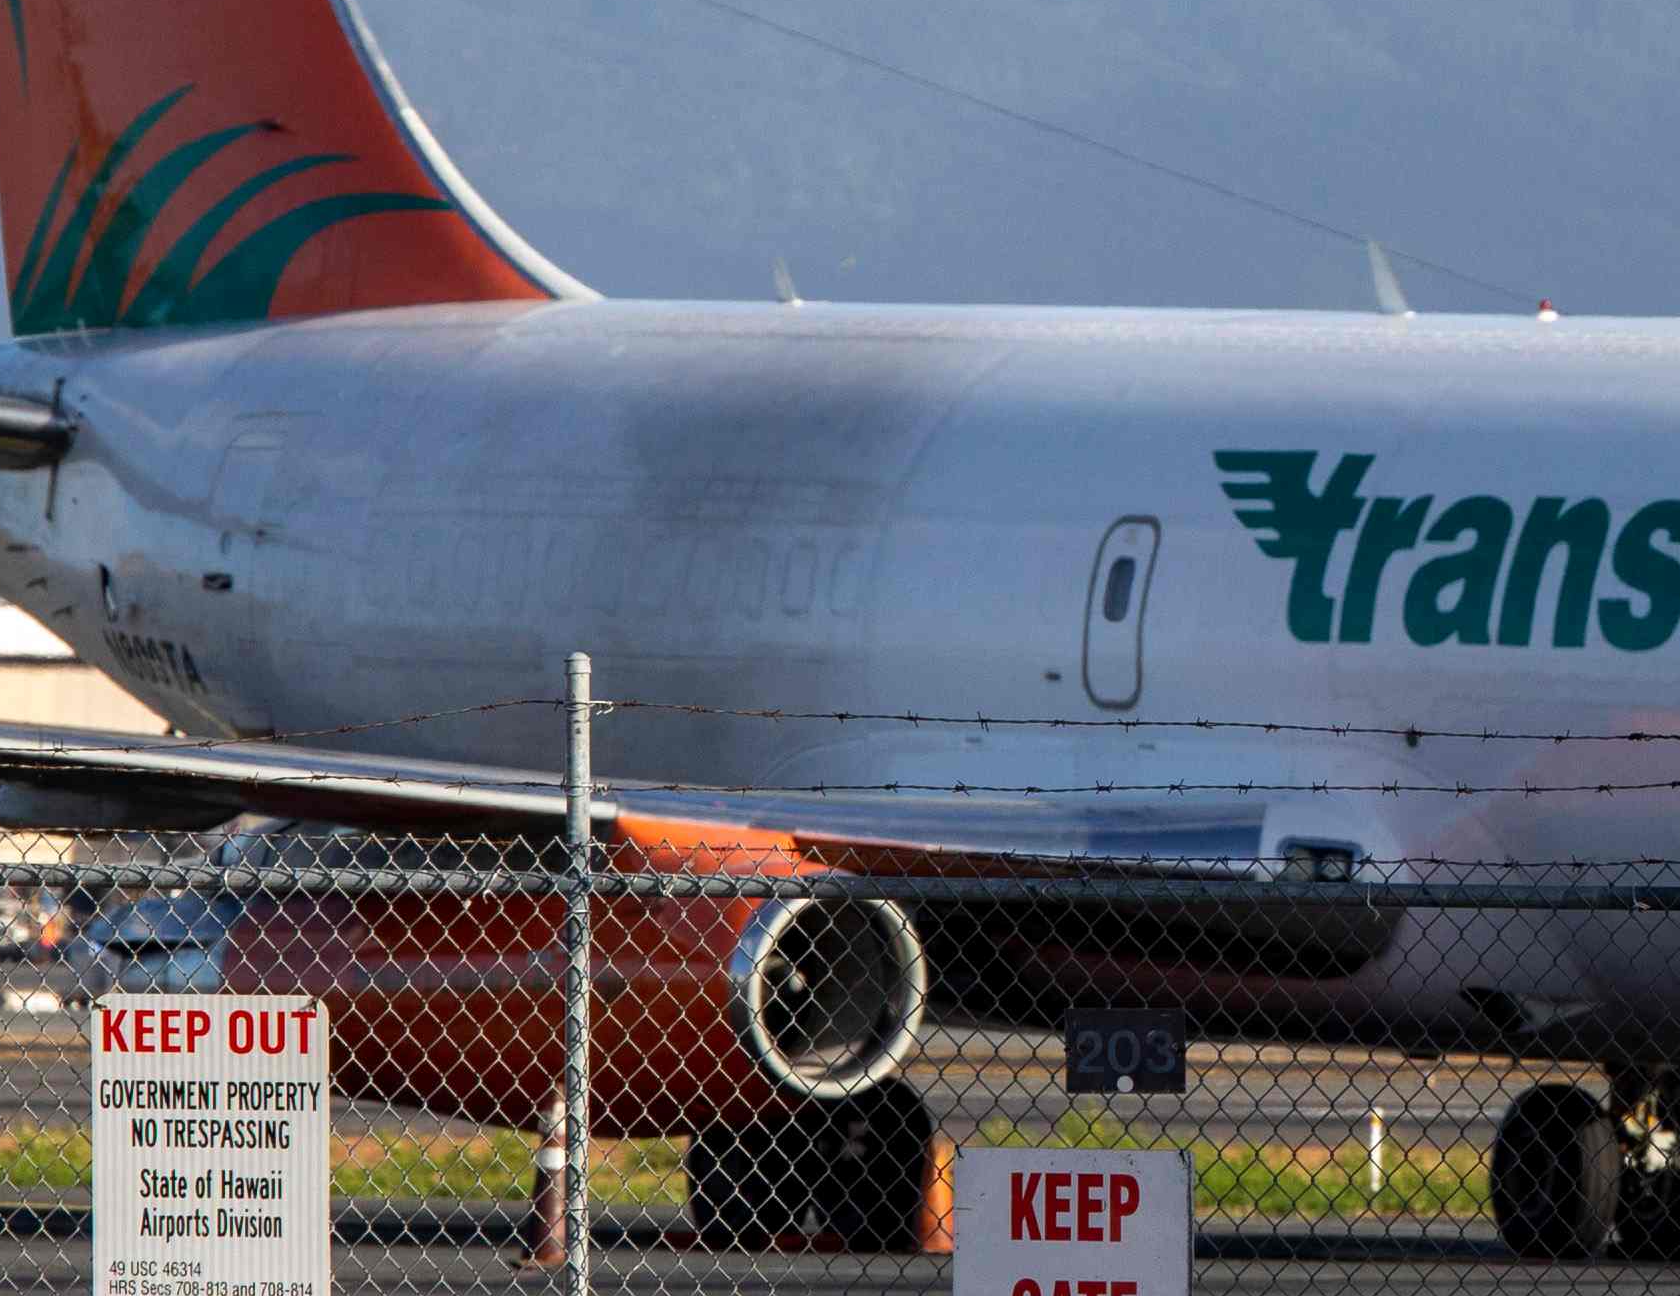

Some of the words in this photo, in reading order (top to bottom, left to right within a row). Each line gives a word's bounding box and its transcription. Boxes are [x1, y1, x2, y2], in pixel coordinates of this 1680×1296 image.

[102, 1009, 211, 1053] KEEP
[228, 1010, 318, 1055] OUT
[1076, 1028, 1177, 1075] 203
[100, 1079, 220, 1110] GOVERNMENT
[227, 1081, 321, 1112] PROPERTY
[131, 1118, 158, 1148] NO
[164, 1119, 291, 1149] TRESPASSING
[139, 1168, 188, 1199] State
[195, 1169, 213, 1199] of
[220, 1169, 283, 1200] Hawaii
[1009, 1171, 1140, 1242] KEEP
[139, 1208, 210, 1243] Airports
[216, 1208, 283, 1238] Division
[109, 1260, 126, 1276] 49
[130, 1261, 158, 1277] USC
[162, 1261, 202, 1277] 46314
[108, 1280, 137, 1296] HRS
[140, 1280, 172, 1296] Secs
[175, 1281, 229, 1296] 708-813
